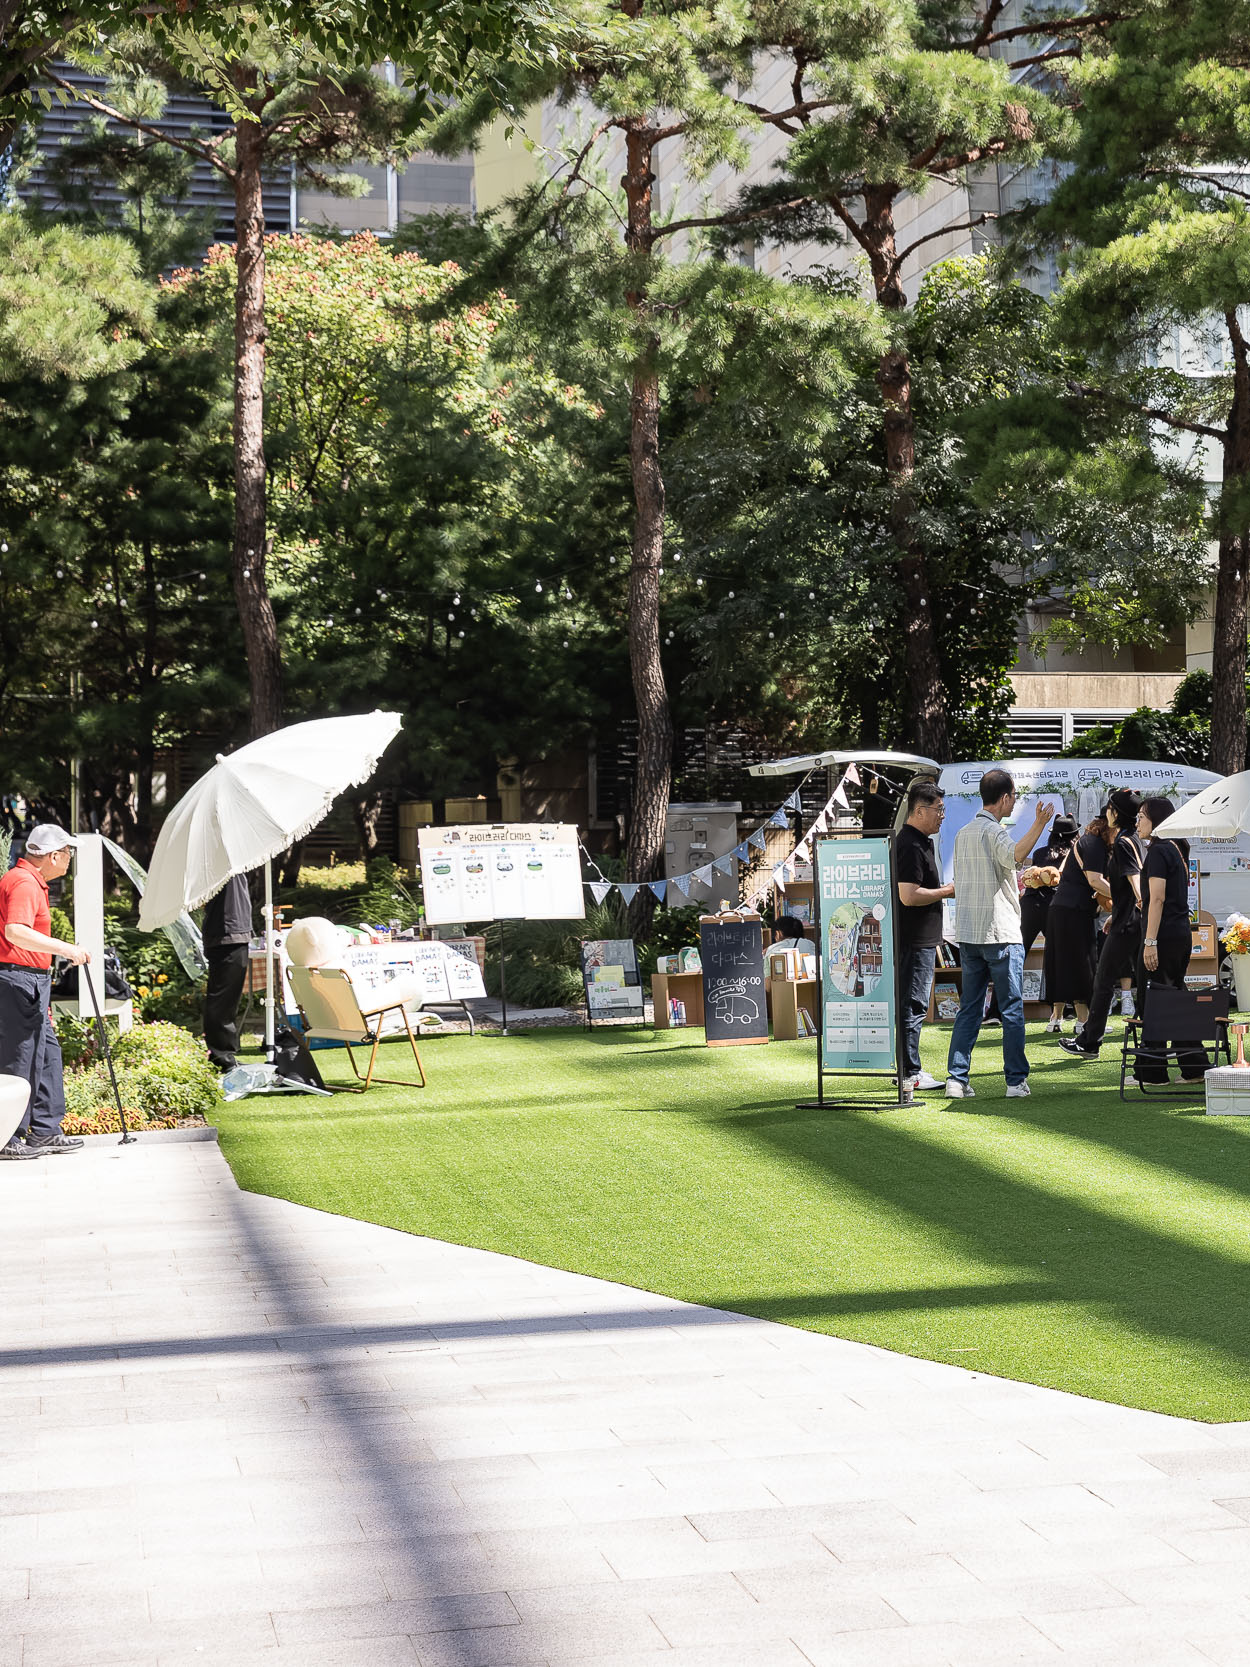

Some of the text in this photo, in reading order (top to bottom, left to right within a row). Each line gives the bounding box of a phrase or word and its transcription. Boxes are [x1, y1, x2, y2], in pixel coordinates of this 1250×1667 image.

[1103, 769, 1152, 779] 라이브러리
[1154, 769, 1184, 779] 다마스
[509, 832, 532, 841] 다마스
[823, 863, 886, 882] 라이브러리
[823, 882, 861, 899] 다마스
[860, 884, 885, 892] LIBRARY
[711, 951, 755, 967] 다마스
